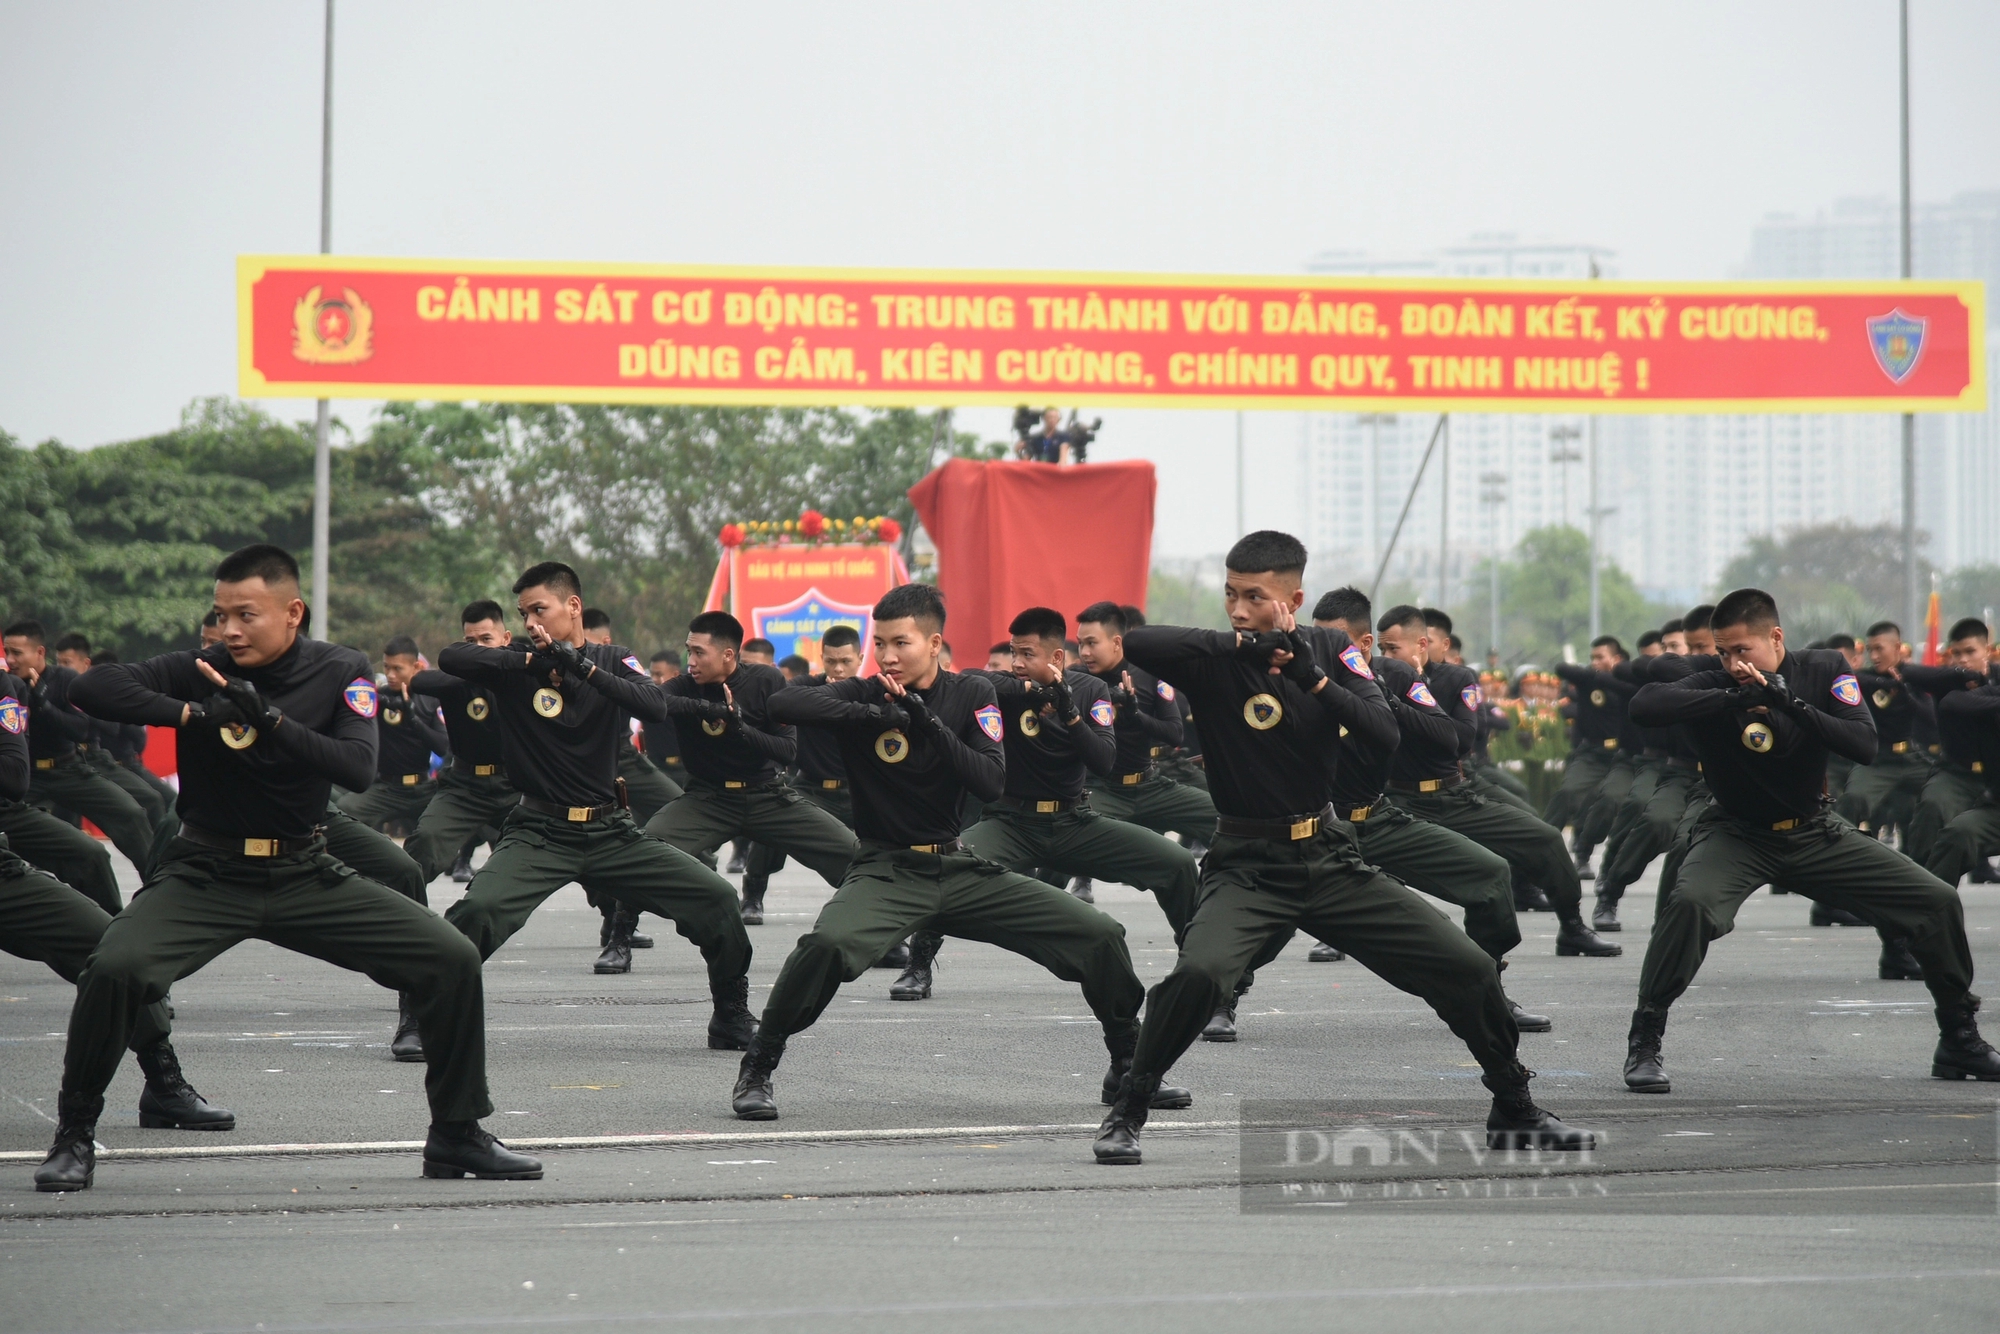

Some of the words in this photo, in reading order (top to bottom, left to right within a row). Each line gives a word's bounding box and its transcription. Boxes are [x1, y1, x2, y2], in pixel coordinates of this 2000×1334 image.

[417, 276, 541, 322] CẢNH
[554, 283, 638, 324] SÁT
[652, 288, 713, 326] CƠ
[723, 287, 859, 332] ĐỘNG:
[870, 295, 1015, 329] TRUNG
[1026, 291, 1169, 332] THÀNH
[1181, 293, 1249, 334] VỚI
[1260, 291, 1389, 338] ĐẢNG,
[1400, 298, 1514, 337] ĐOÀN
[1525, 297, 1604, 341] KẾT,
[1616, 297, 1668, 339] KỶ
[1679, 304, 1829, 341] CƯƠNG,
[618, 338, 741, 380] DŨNG
[754, 337, 868, 384] CẢM,
[881, 342, 984, 383] KIÊN
[995, 344, 1156, 387] CƯỜNG,
[1168, 347, 1298, 386] CHÍNH
[1310, 354, 1396, 389] QUY,
[1408, 355, 1502, 388] TINH
[1514, 353, 1622, 395] NHUỆ
[1636, 358, 1649, 390] !
